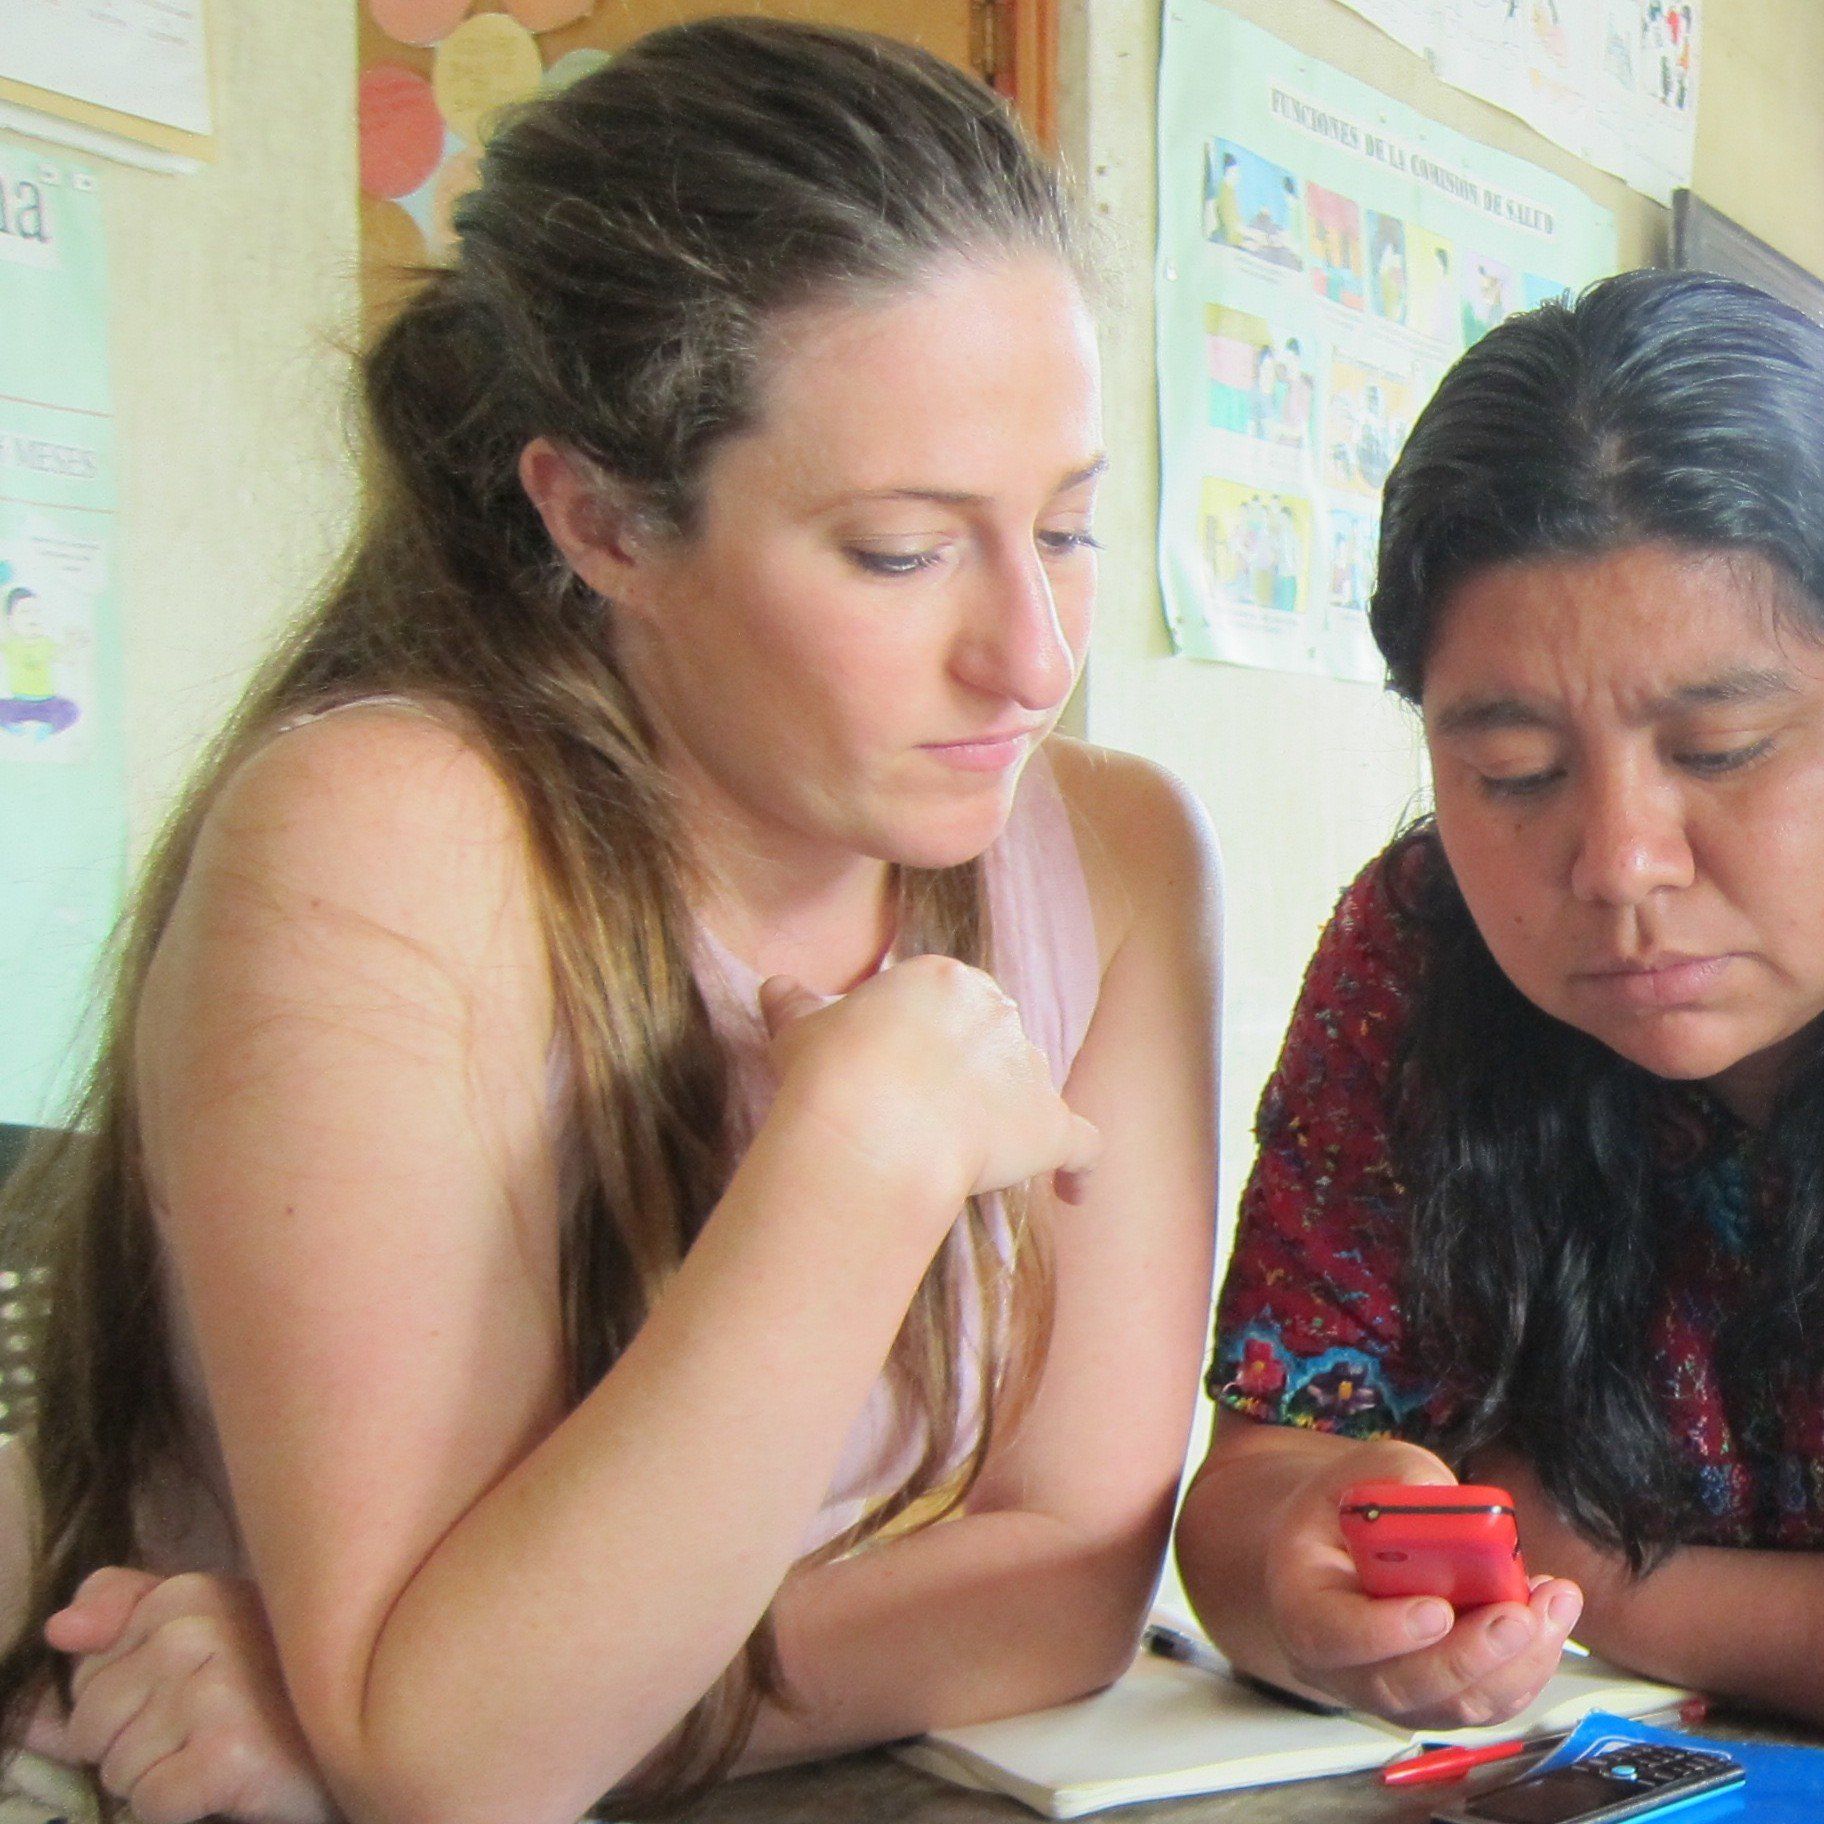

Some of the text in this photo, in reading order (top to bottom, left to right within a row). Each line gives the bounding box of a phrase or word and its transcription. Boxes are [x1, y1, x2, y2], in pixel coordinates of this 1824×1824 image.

[1271, 86, 1359, 151] FUNCIONES
[1364, 132, 1386, 163] DE
[1387, 144, 1407, 171] LA
[1483, 188, 1502, 217] DE
[1506, 198, 1555, 236] SALUD
[14, 437, 97, 480] MESES
